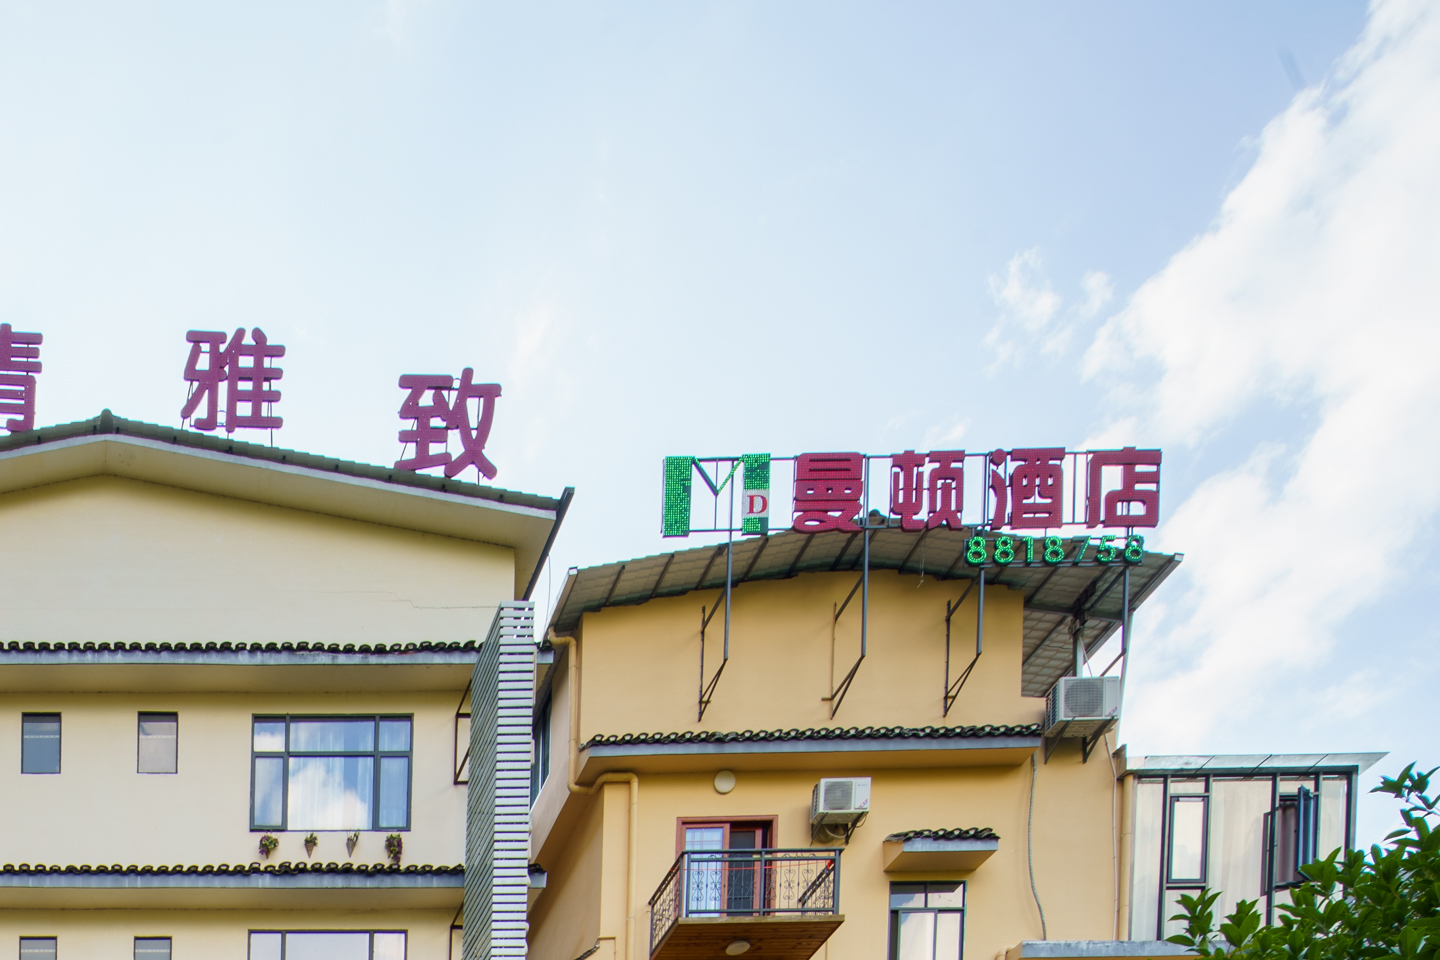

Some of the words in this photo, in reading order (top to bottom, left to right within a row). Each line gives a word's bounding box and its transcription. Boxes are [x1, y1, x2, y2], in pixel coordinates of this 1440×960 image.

[791, 446, 1162, 535] 曼顿酒店
[964, 534, 1145, 568] 8818758
